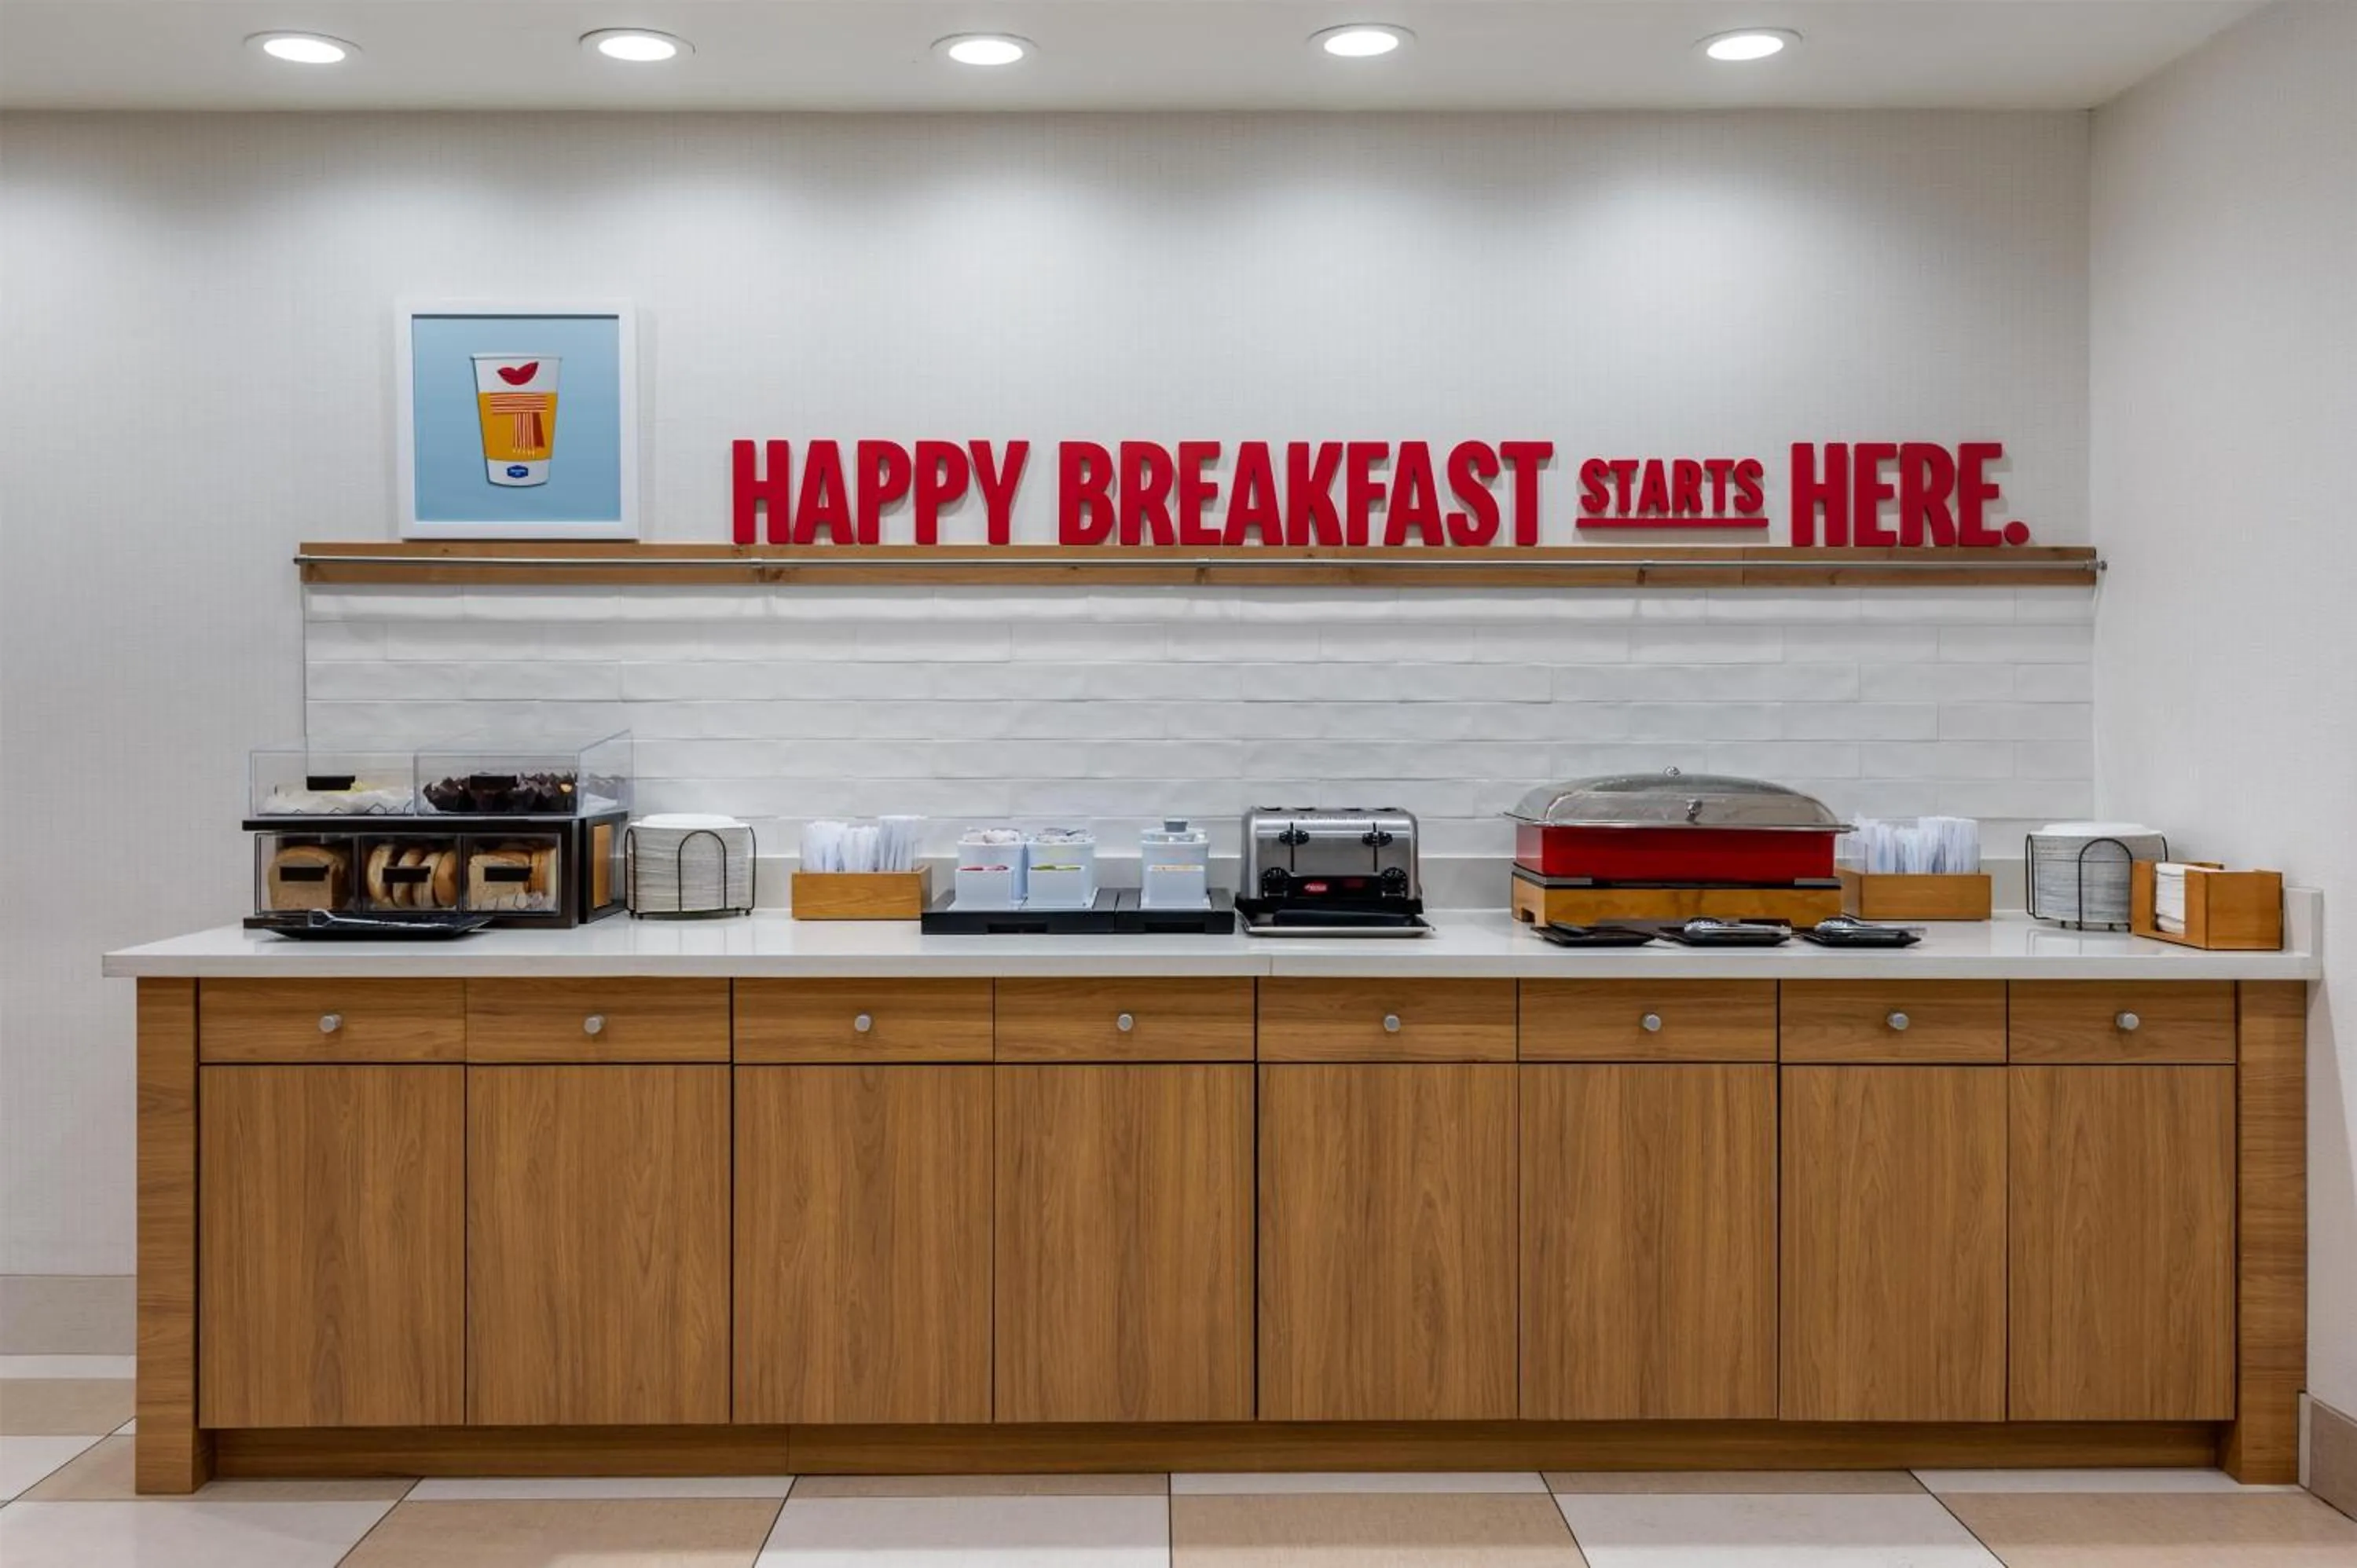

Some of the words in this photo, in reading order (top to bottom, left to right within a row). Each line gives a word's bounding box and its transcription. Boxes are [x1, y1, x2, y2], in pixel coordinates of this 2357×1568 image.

[731, 439, 1029, 547] HAPPY
[1058, 440, 1554, 548] BREAKFAST
[1579, 458, 1765, 515] STARTS
[1791, 442, 2029, 548] HERE.
